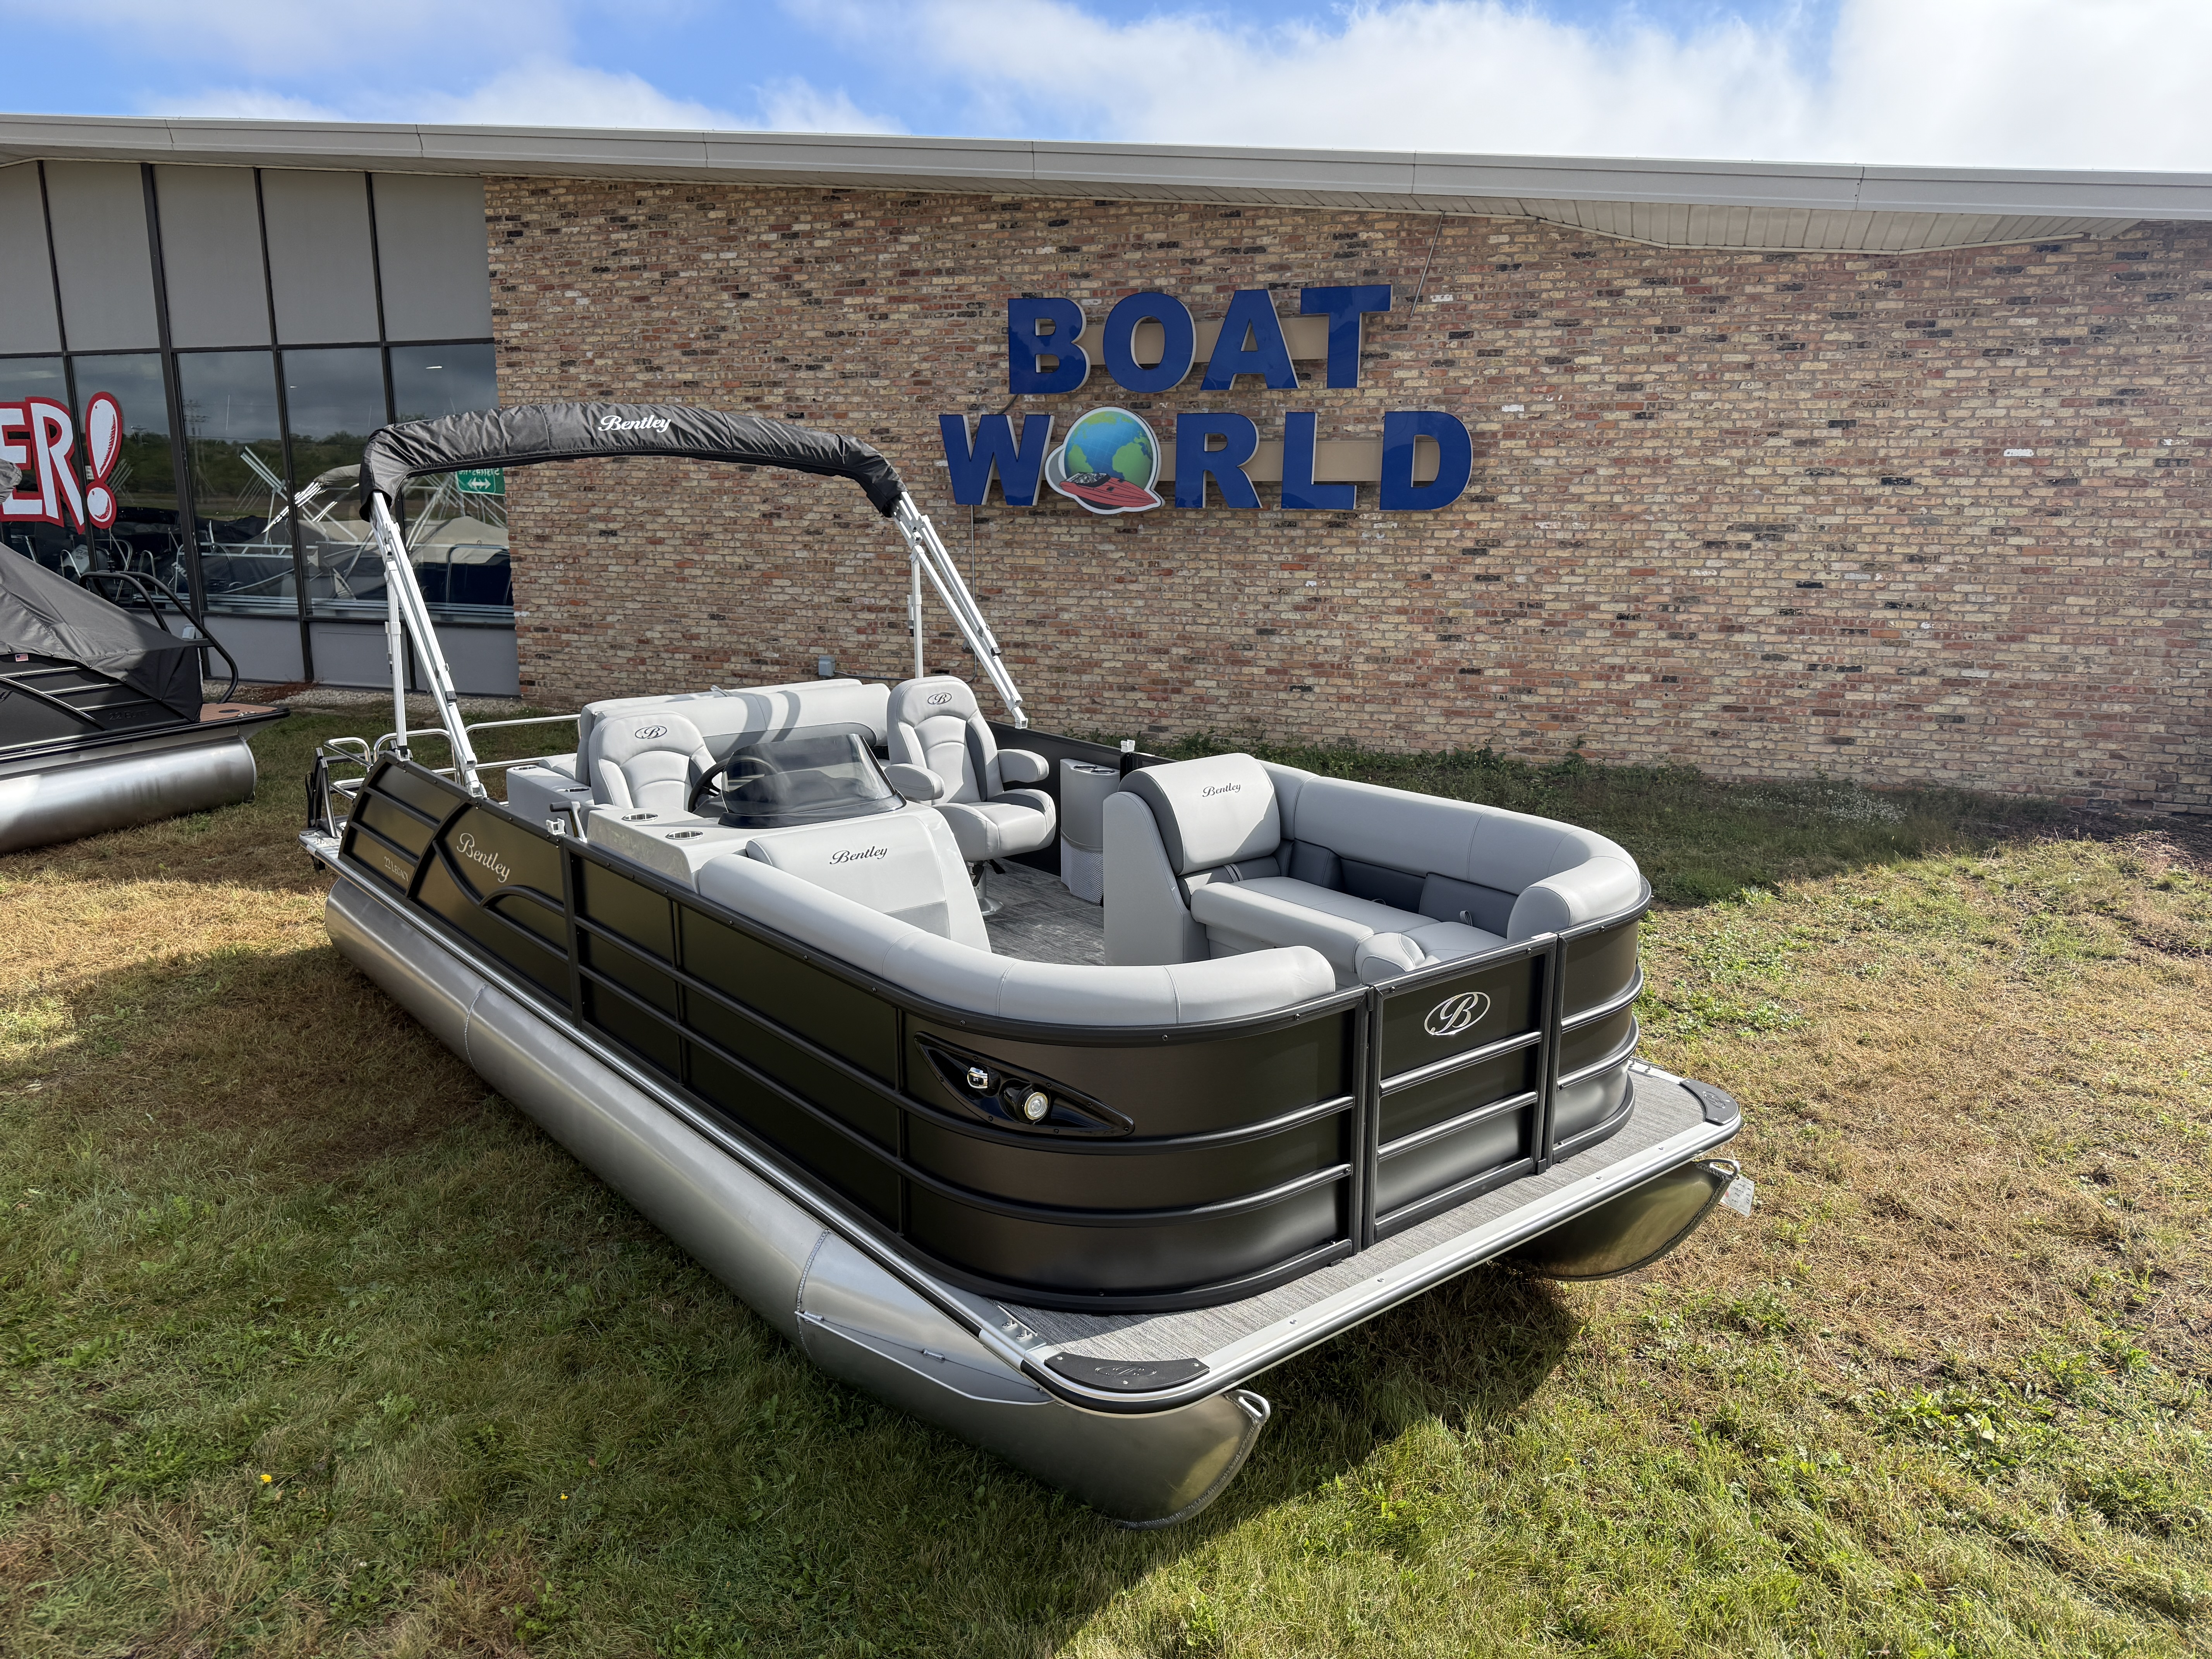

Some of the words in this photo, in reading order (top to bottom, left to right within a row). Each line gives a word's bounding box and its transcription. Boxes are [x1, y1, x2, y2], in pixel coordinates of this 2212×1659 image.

[1008, 284, 1393, 394] BOAT
[598, 414, 672, 433] Bentley
[1202, 783, 1241, 797] Bentley
[457, 833, 510, 883] Bentley
[829, 846, 888, 864] Bentley
